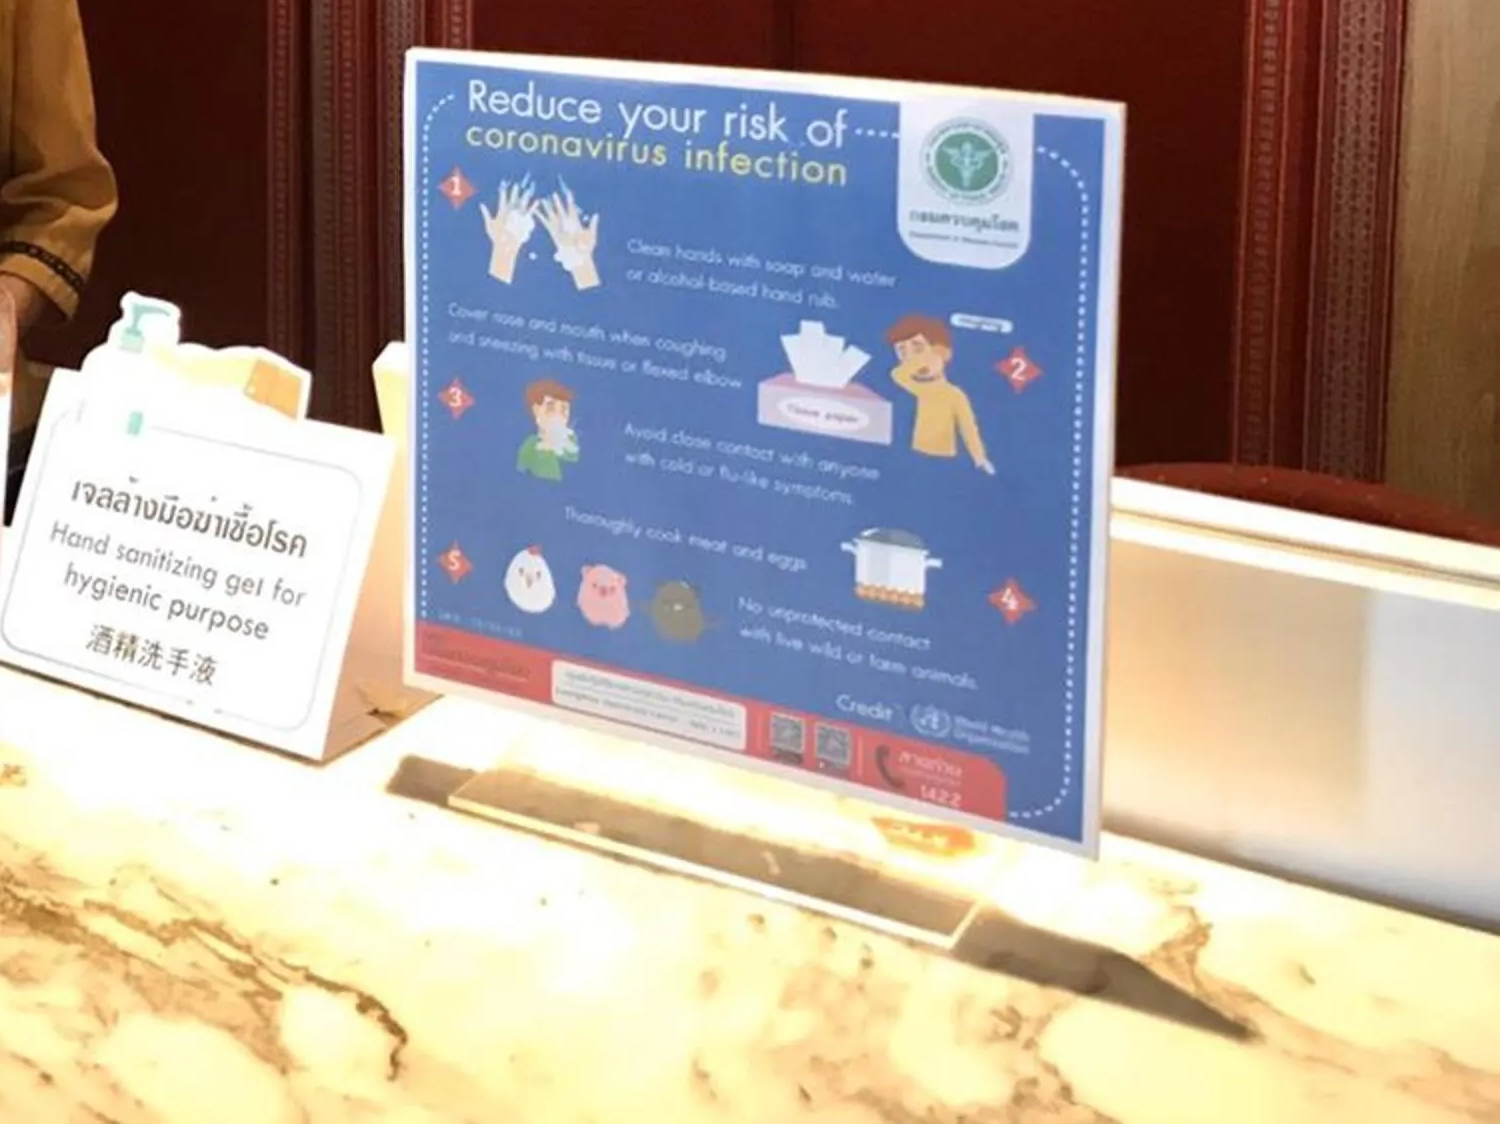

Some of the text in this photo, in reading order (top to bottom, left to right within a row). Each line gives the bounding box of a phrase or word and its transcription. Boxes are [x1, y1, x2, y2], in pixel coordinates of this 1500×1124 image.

[467, 79, 848, 148] Reduce your risk of
[465, 124, 848, 186] coronavirus infection
[450, 174, 463, 196] 1
[626, 238, 898, 289] Clean hands with soap and water
[626, 268, 643, 281] or
[648, 269, 758, 298] alcohol-based
[761, 284, 803, 304] hand
[448, 301, 727, 363] Cover nose and mouth when coughing
[450, 330, 475, 346] and
[478, 335, 539, 361] sneezing
[543, 345, 574, 363] with
[621, 359, 637, 373] or
[1009, 357, 1027, 381] 2
[450, 387, 463, 409] 3
[624, 422, 880, 481] Avoid close contact with anyone
[625, 452, 655, 467] with
[659, 457, 693, 475] cold
[698, 465, 715, 477] or
[71, 476, 308, 559] เจลล้างมือฆ่าเชื้อโรค
[564, 505, 641, 539] Thoroughly
[646, 525, 683, 544] cook
[688, 534, 728, 554] meat
[732, 543, 764, 562] and
[49, 519, 307, 609] Hand sanitizing gel for
[63, 561, 270, 641] hygienic purpose
[738, 596, 932, 651] No unprotected contact
[1001, 586, 1019, 610] 4
[85, 621, 219, 687] 酒精洗手液
[739, 626, 772, 643] with
[775, 631, 804, 651] live
[808, 641, 842, 661] wild
[846, 651, 864, 664] or
[869, 652, 909, 675] farm
[835, 694, 894, 722] Credit
[920, 784, 962, 807] 1422
